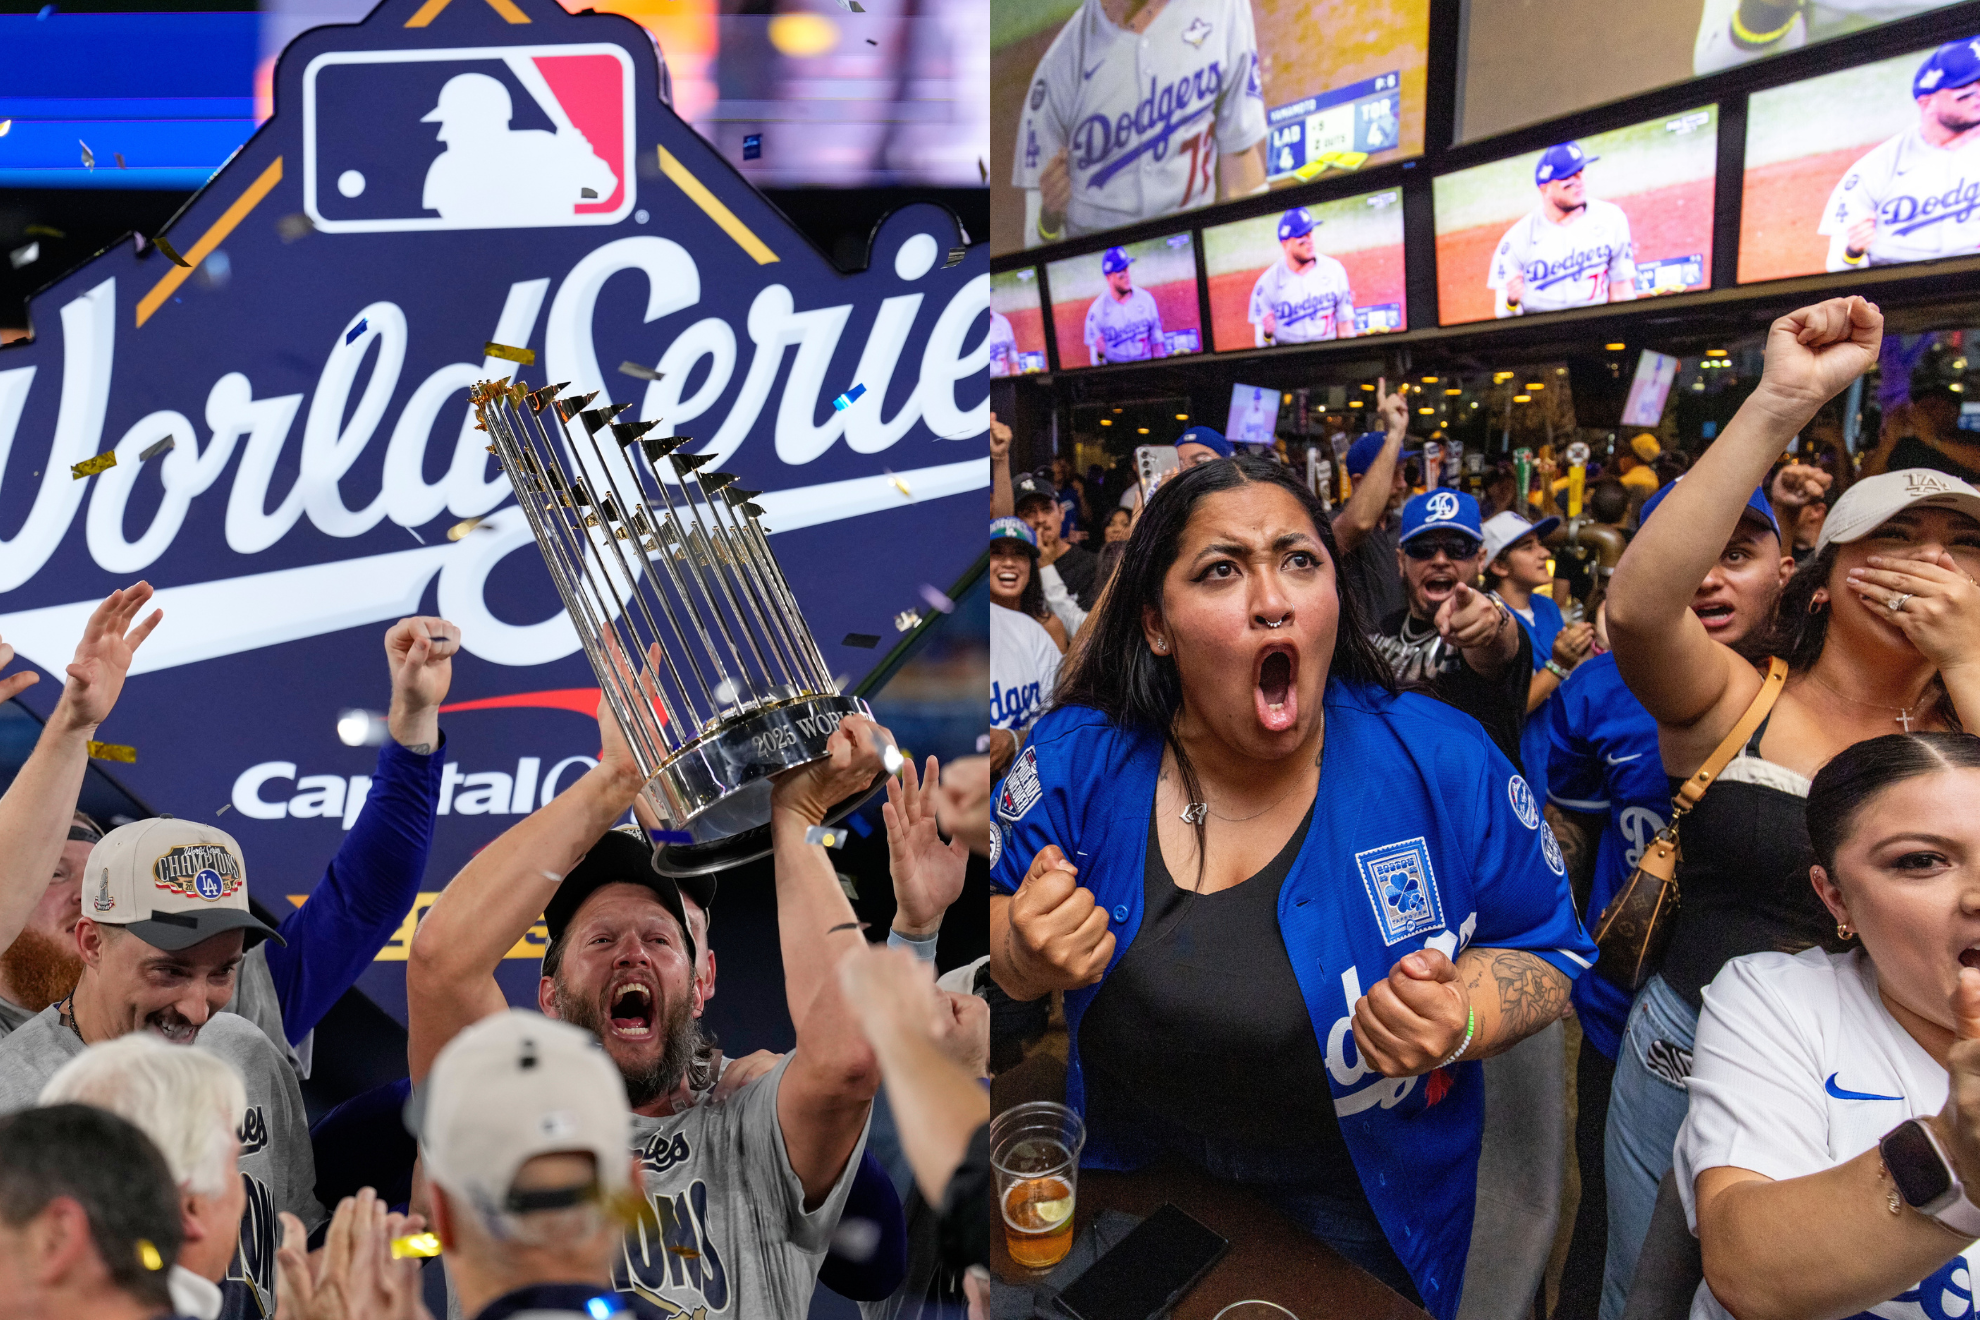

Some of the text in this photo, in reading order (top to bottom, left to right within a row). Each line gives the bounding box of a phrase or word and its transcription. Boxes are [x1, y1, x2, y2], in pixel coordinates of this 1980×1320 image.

[1073, 61, 1222, 170] Dodgers
[1903, 472, 1952, 497] LA
[752, 711, 856, 758] 2025 WOR
[232, 757, 540, 830] Captal
[158, 850, 240, 882] CHAMPIONS
[200, 873, 218, 896] LA
